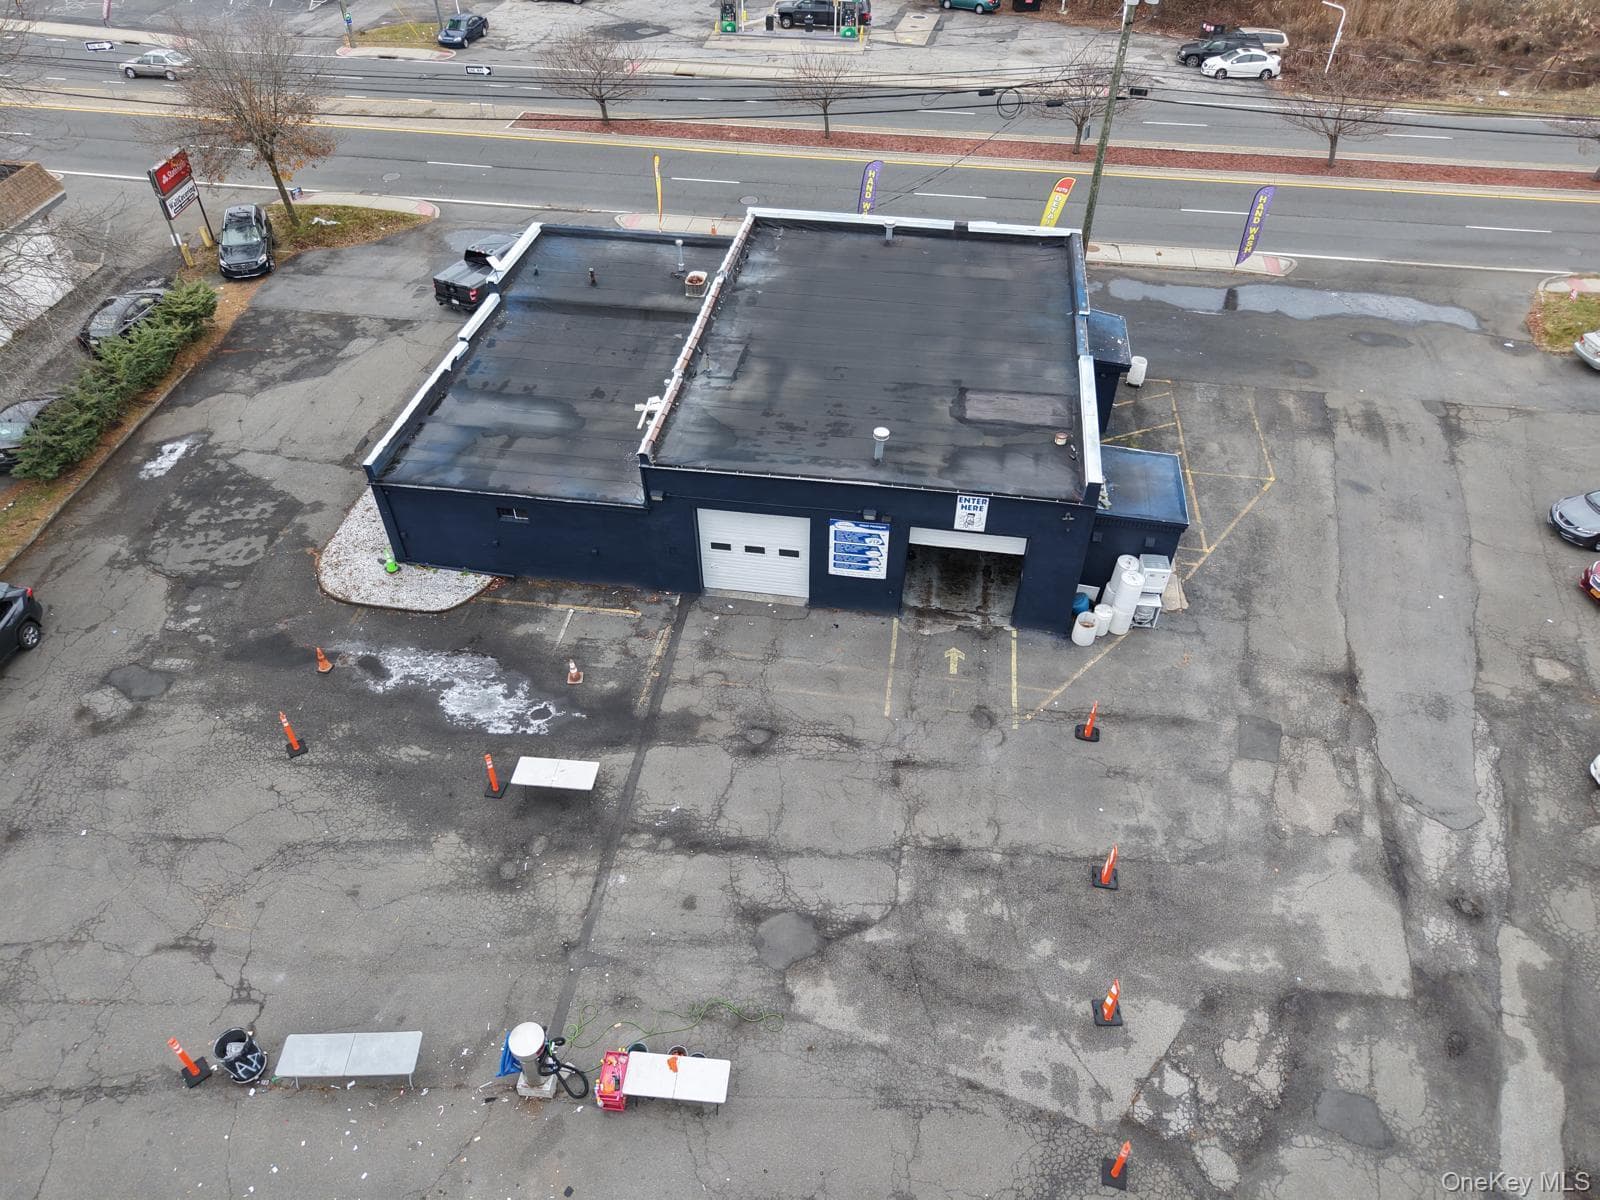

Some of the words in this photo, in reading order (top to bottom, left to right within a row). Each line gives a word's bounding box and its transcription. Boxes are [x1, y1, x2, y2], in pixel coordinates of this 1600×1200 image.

[865, 170, 876, 199] HAND
[1252, 195, 1268, 224] HAND
[1244, 226, 1259, 254] WASH
[958, 496, 988, 505] ENTER
[960, 504, 985, 512] HERE
